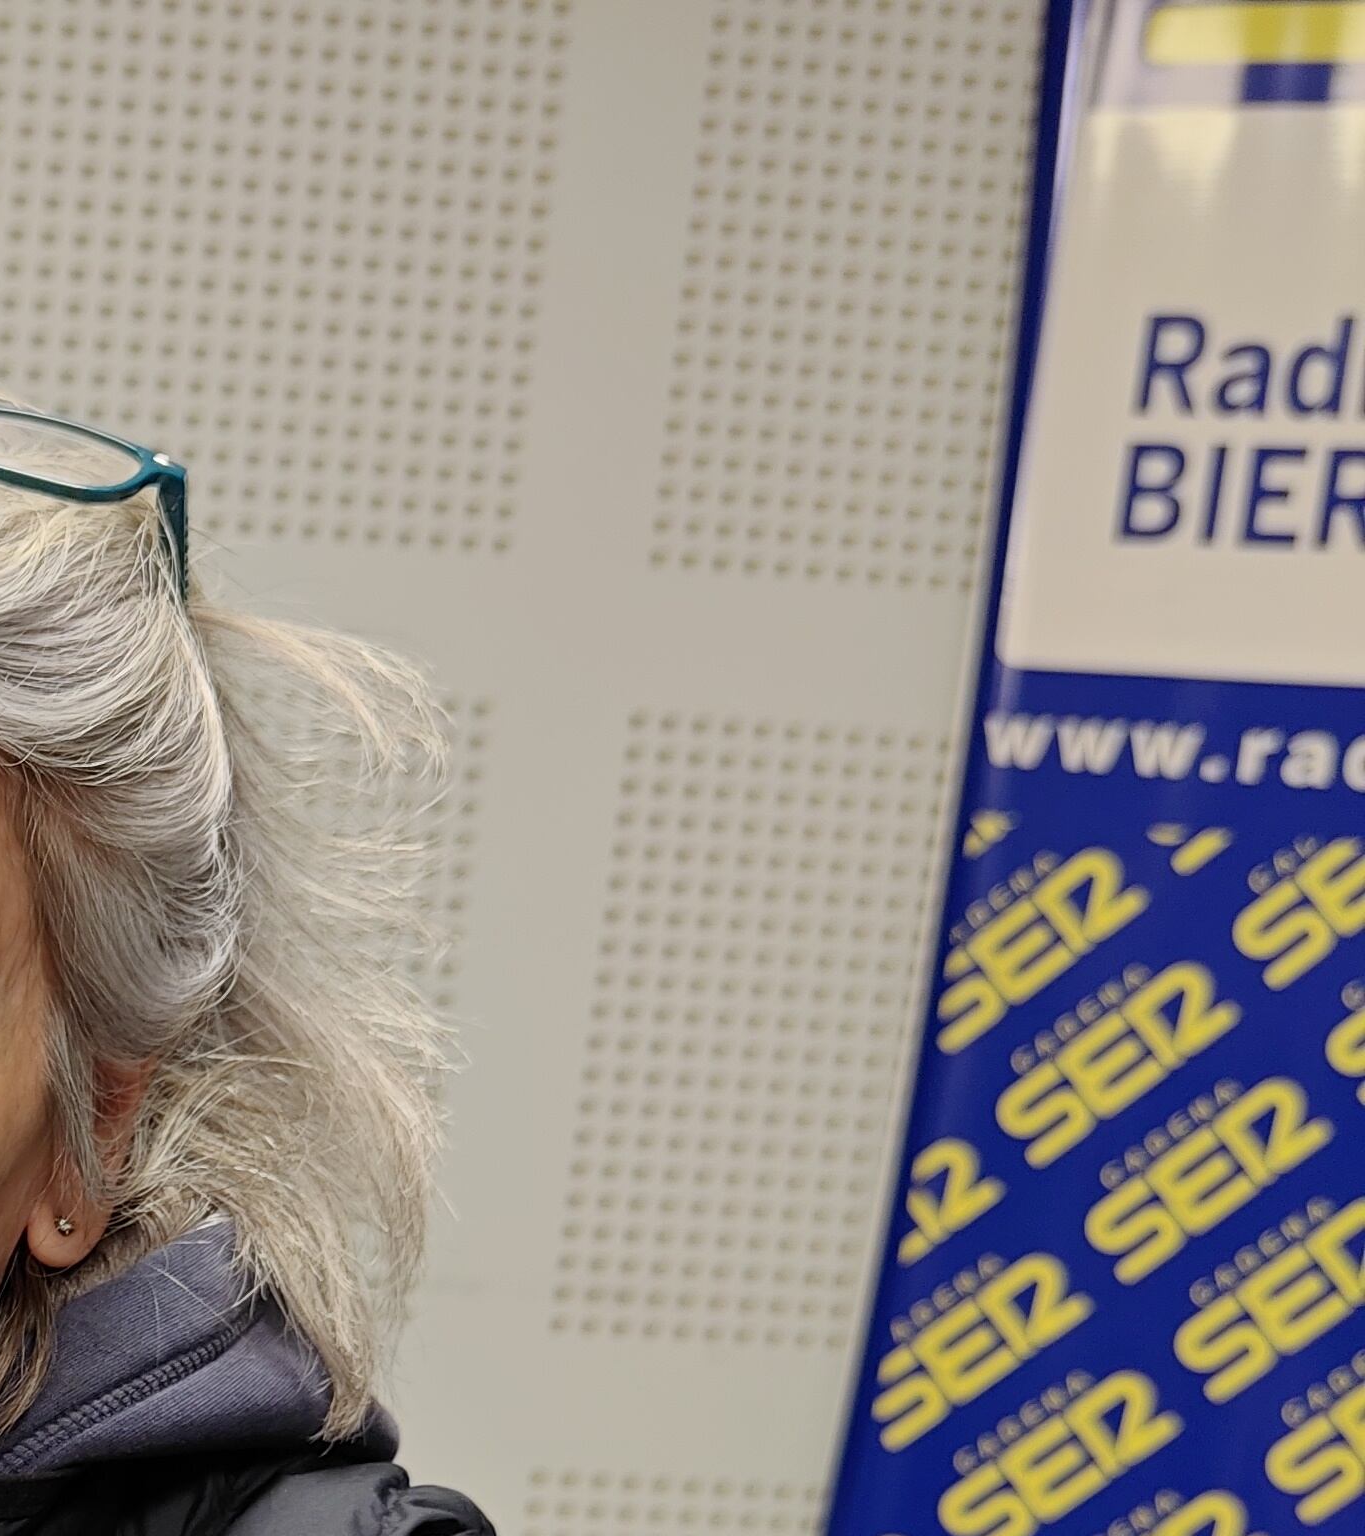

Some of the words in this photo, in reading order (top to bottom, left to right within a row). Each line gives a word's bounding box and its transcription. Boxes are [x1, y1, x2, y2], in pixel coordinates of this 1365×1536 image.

[1232, 837, 1365, 991] SE
[995, 961, 1242, 1168] SER
[1085, 1077, 1335, 1285] SER
